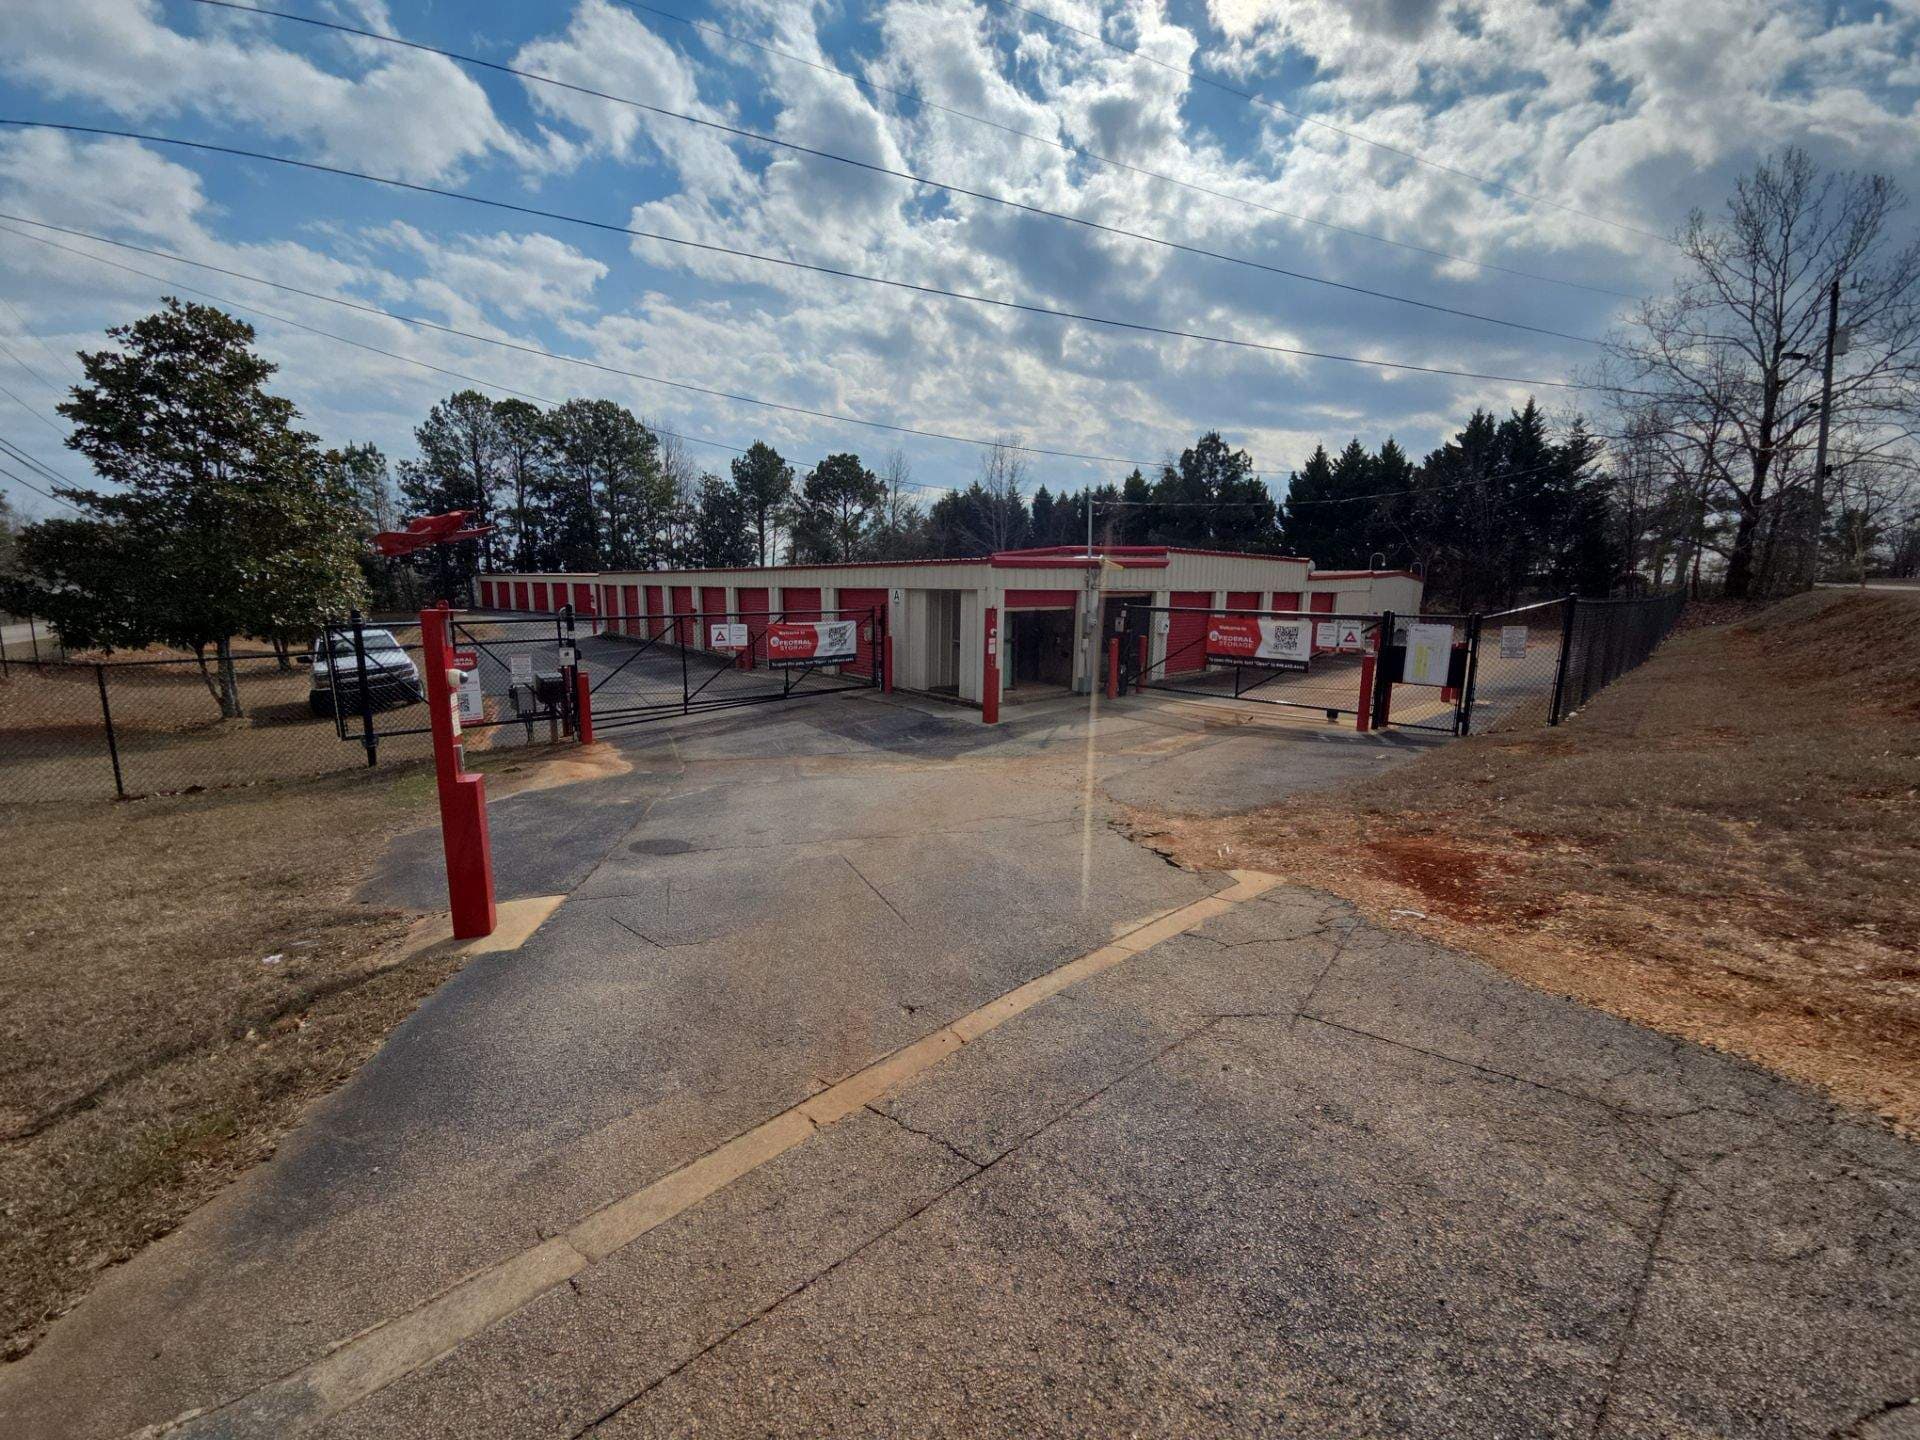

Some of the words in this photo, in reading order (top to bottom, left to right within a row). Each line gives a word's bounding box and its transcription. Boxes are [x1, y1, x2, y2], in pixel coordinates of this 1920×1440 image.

[893, 590, 900, 601] A
[1218, 635, 1254, 643] FEDERAL
[1218, 640, 1254, 649] STORAGE
